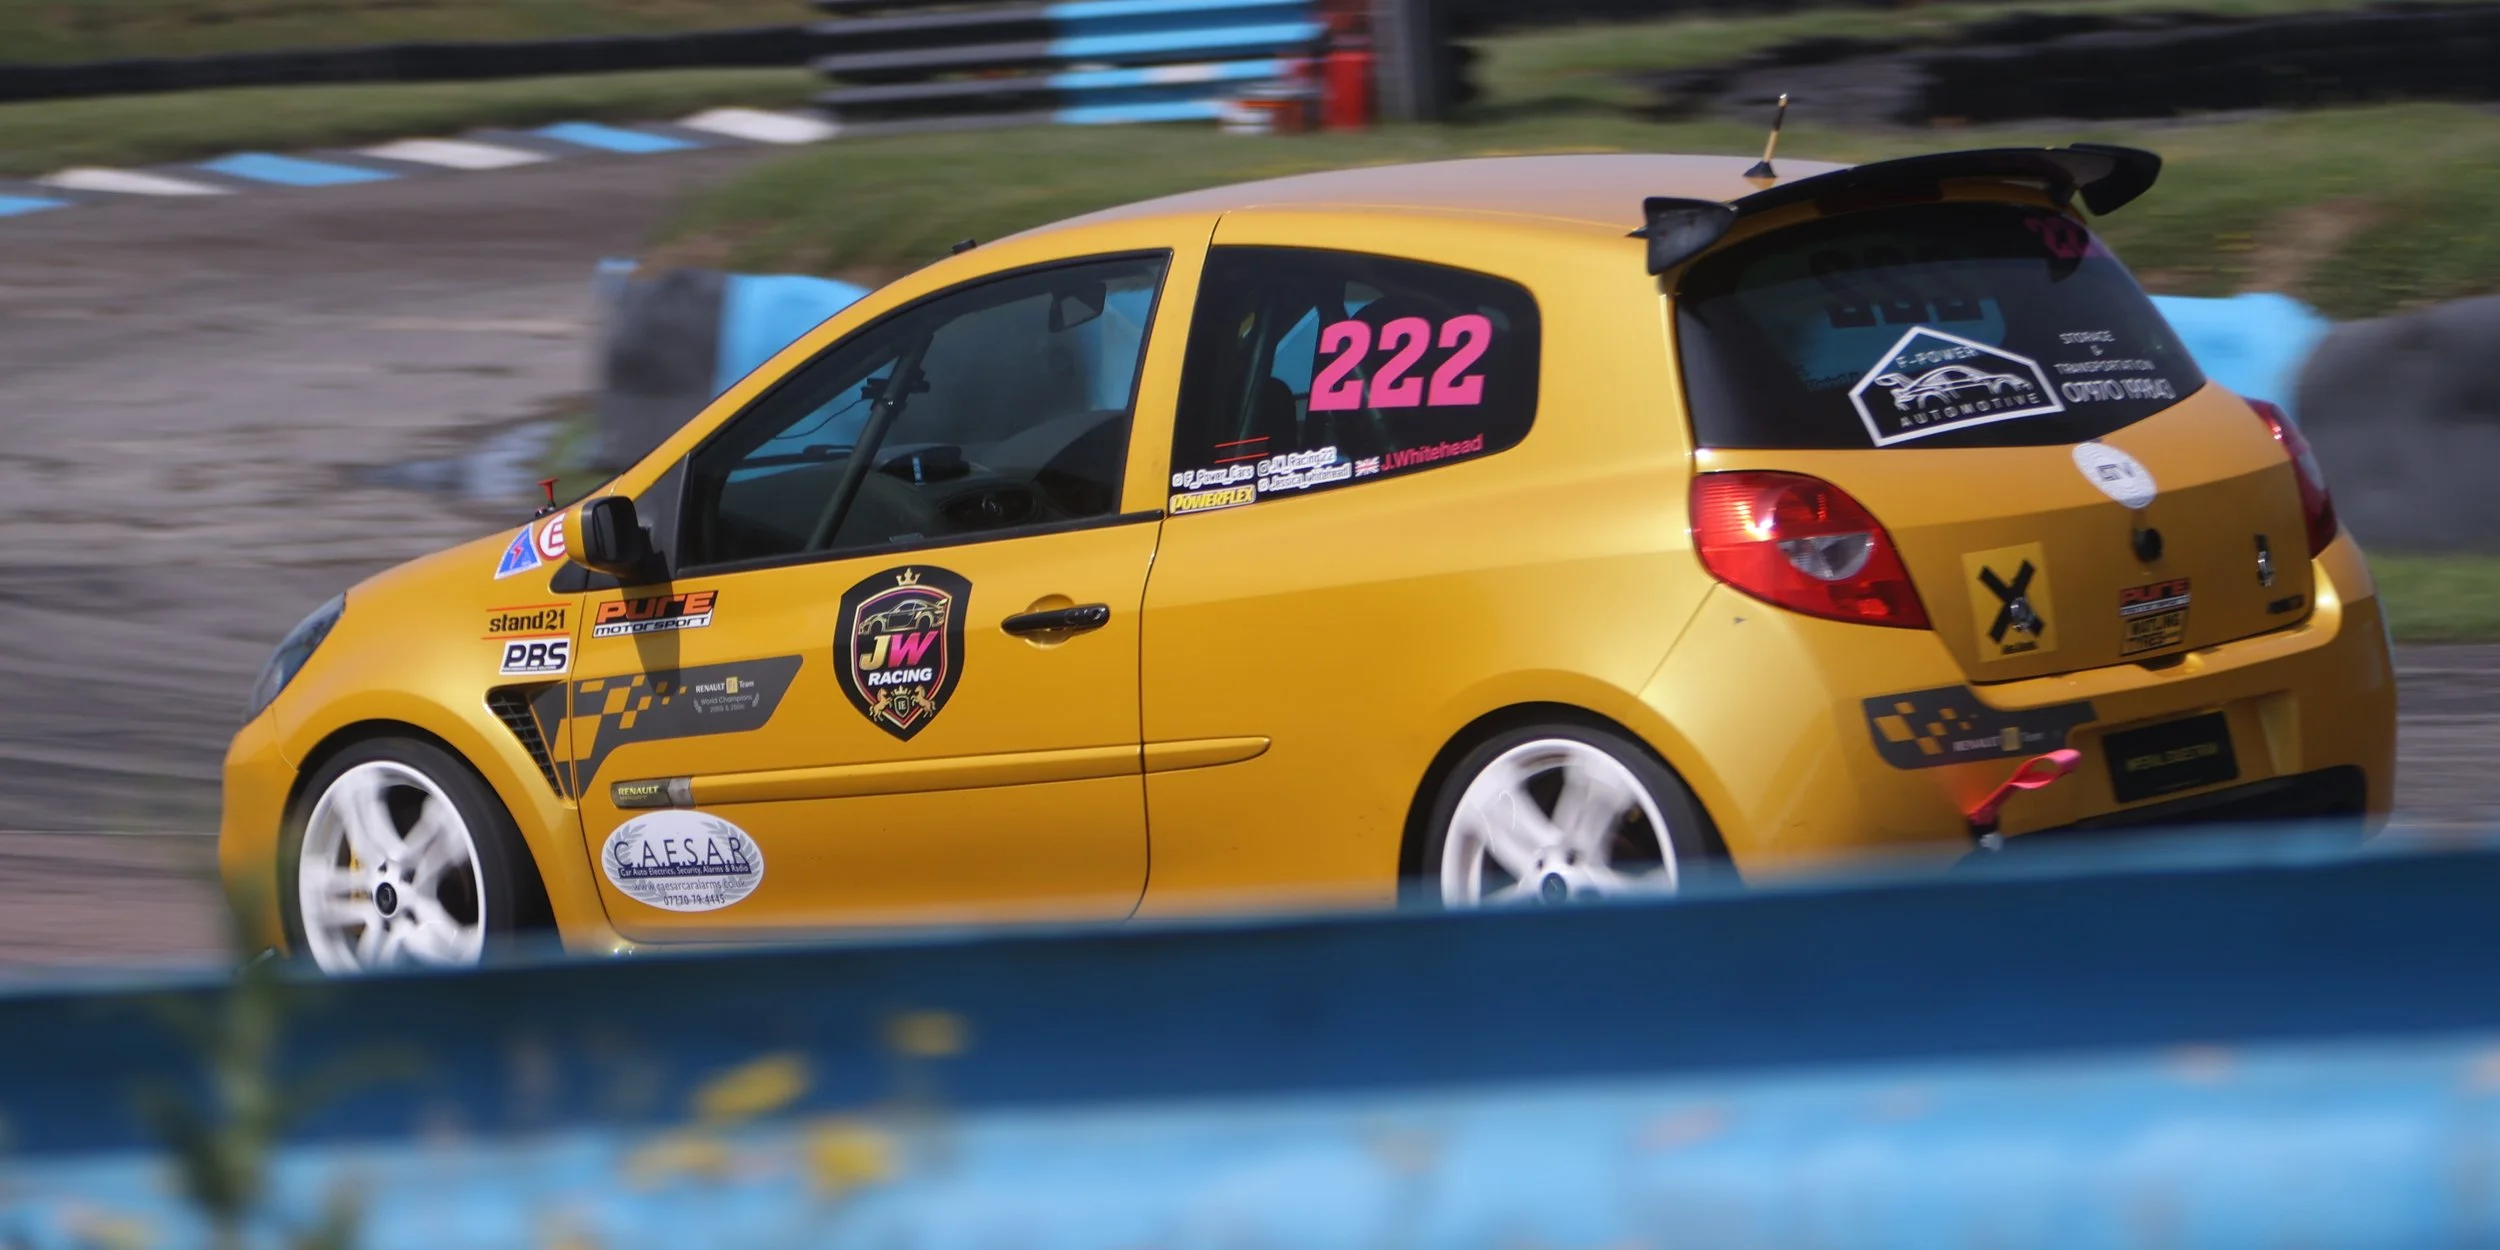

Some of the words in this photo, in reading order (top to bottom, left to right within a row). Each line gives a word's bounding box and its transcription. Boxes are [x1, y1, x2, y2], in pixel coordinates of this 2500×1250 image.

[2059, 330, 2116, 344] STORAGE
[1309, 314, 1492, 411] 222
[1896, 346, 1979, 368] F-POWER
[1900, 393, 2040, 427] AUTOMOTIVE
[1171, 488, 1253, 512] POWERFLEX
[504, 642, 568, 669] PBS
[859, 631, 938, 670] JW
[696, 682, 725, 693] RENAULT
[868, 668, 932, 686] RACING
[618, 786, 658, 795] RENAULT
[620, 868, 632, 876] Car
[633, 867, 648, 876] Auto
[703, 865, 723, 874] Alarms
[725, 865, 730, 873] &
[732, 865, 748, 873] Radio
